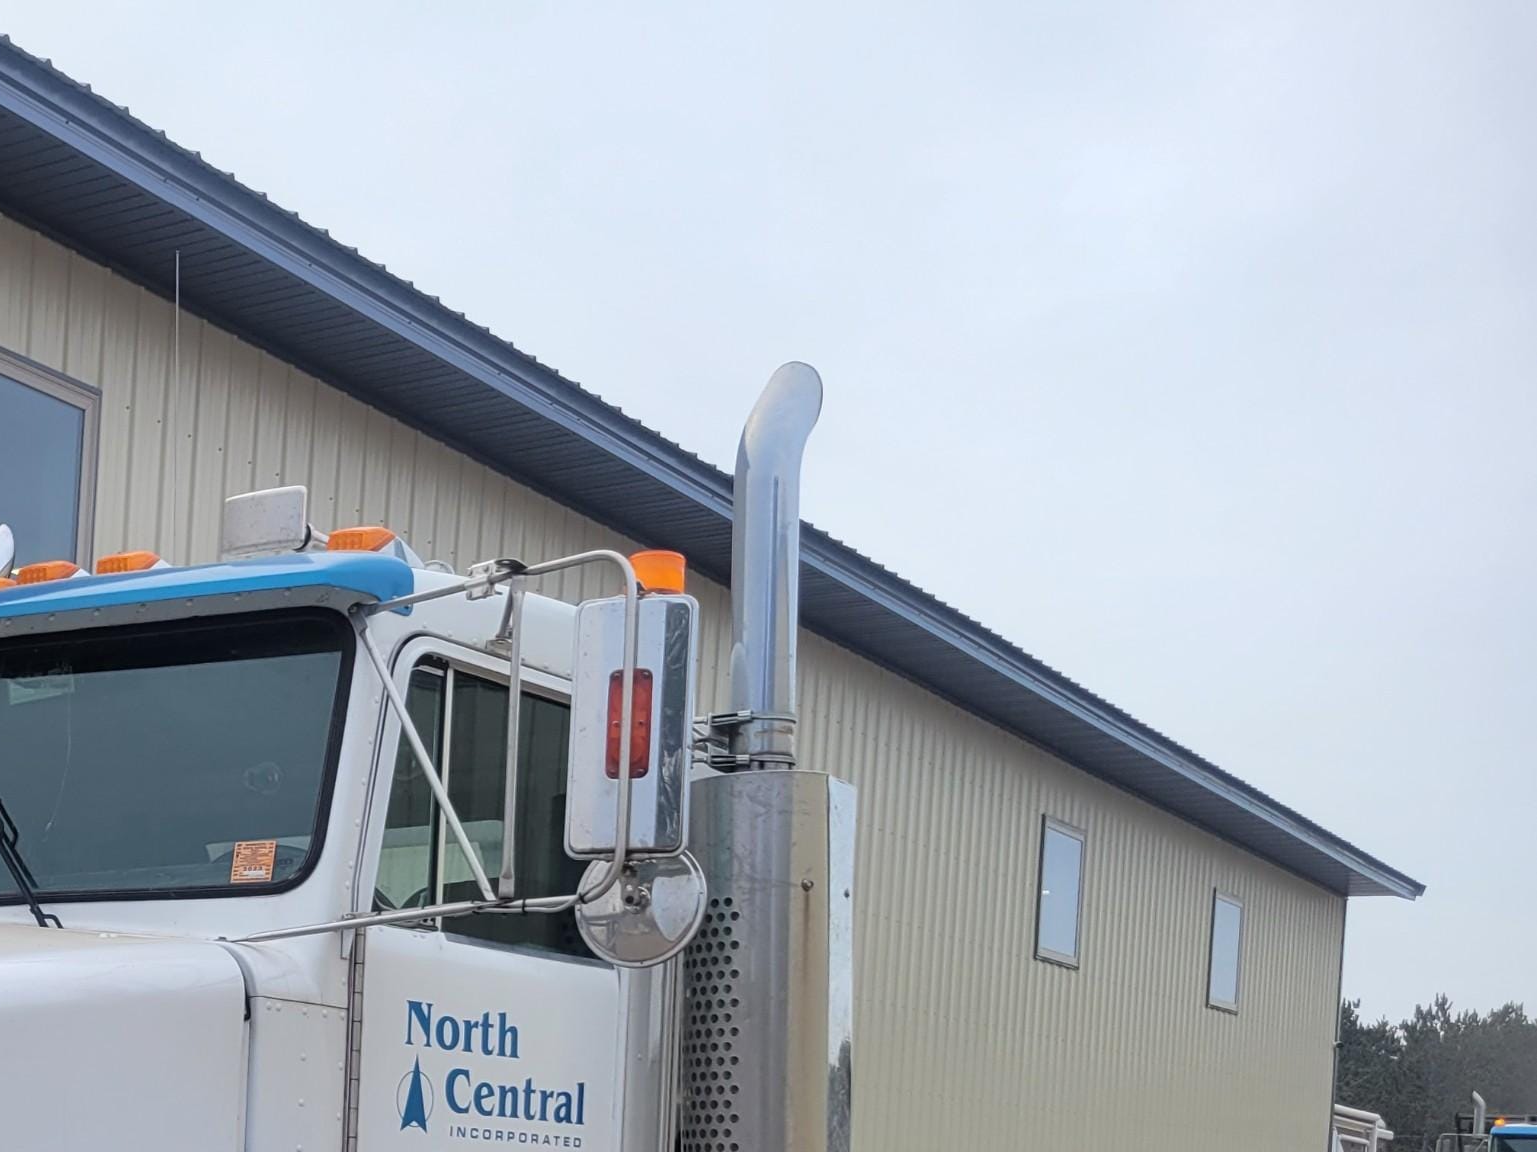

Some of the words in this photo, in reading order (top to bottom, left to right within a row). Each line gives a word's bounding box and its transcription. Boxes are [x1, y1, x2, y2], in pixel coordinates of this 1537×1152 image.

[405, 1000, 519, 1058] North
[445, 1069, 584, 1125] Central
[449, 1126, 582, 1148] INCORPORATED
